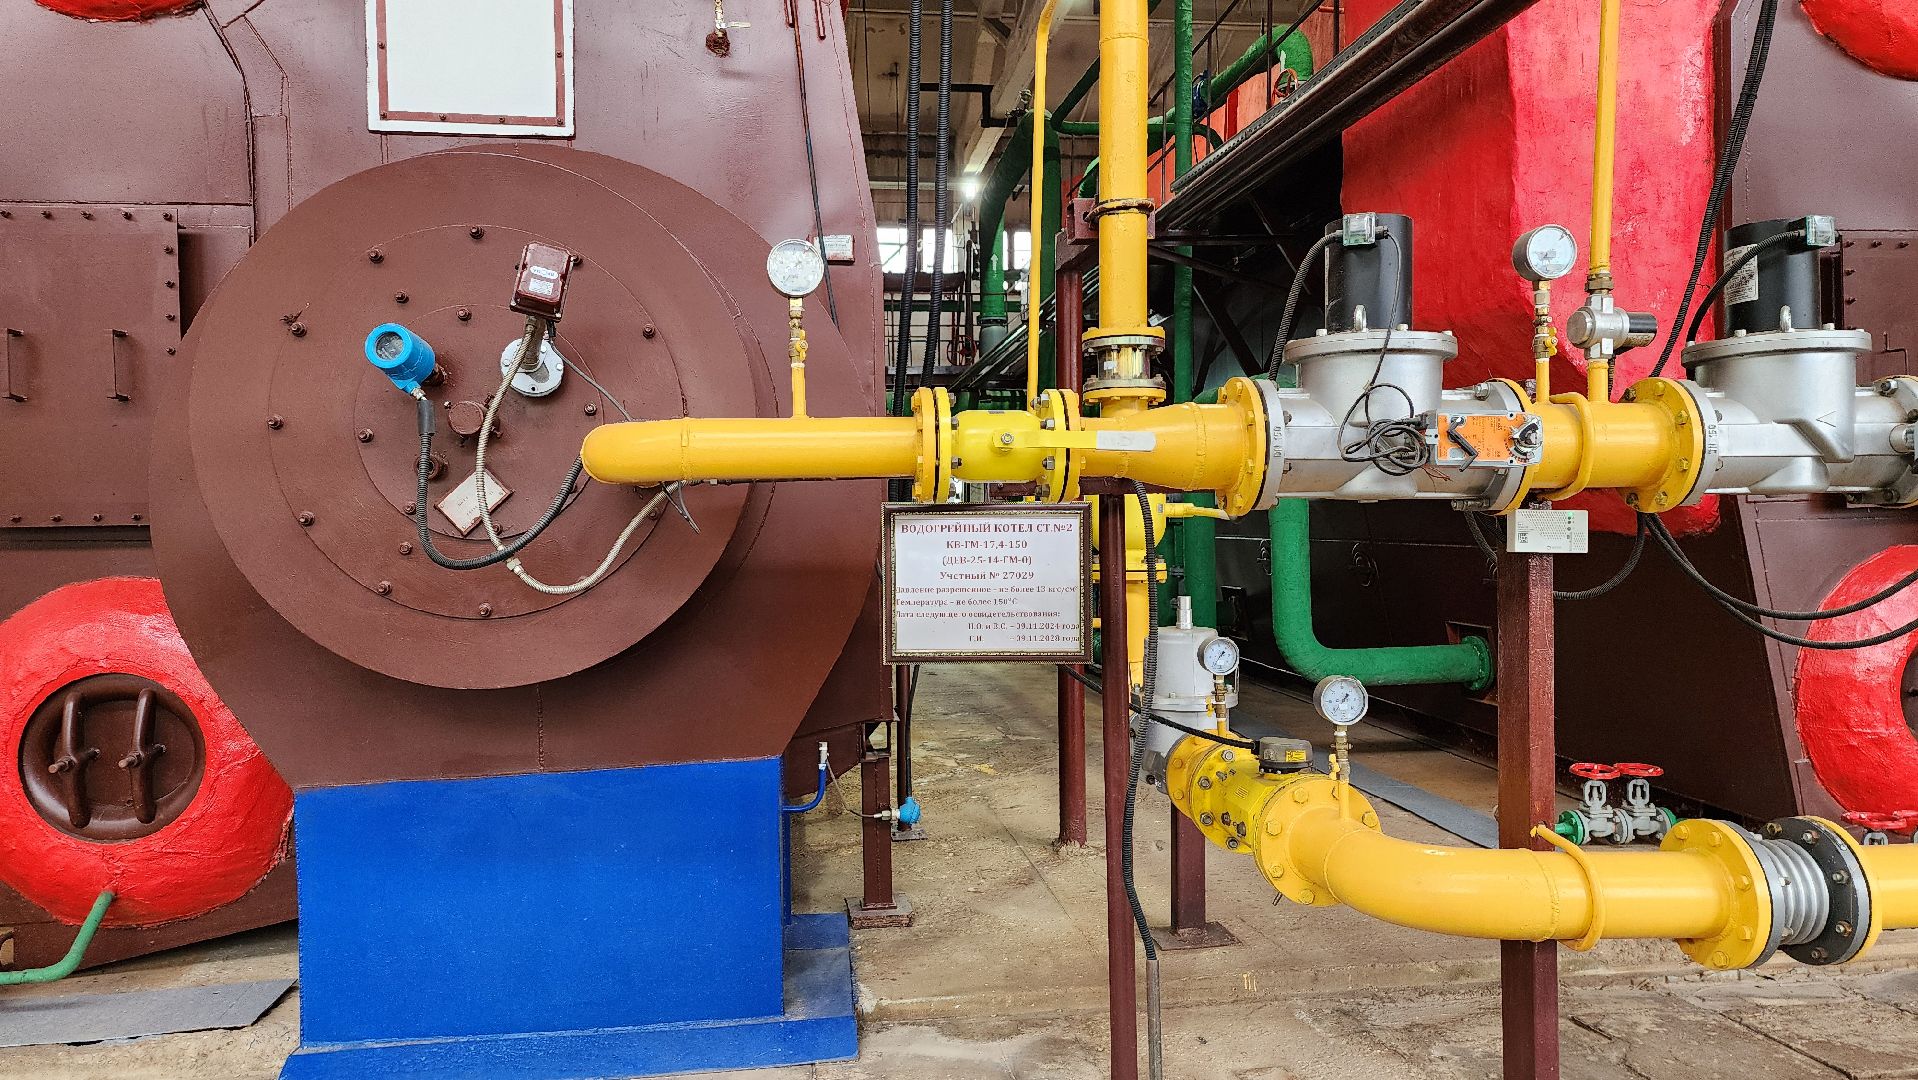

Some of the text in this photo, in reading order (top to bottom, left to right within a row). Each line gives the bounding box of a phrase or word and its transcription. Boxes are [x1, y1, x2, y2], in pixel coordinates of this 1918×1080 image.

[901, 523, 991, 534] ВОДОГРЕЙНЫЙ
[994, 524, 1033, 533] КОТЕЛ
[946, 540, 1028, 550] КВ-ГМ-17,4-150
[989, 571, 1000, 580] №
[1002, 571, 1035, 580] 27029
[1010, 585, 1035, 593] более
[1036, 585, 1046, 593] 13
[956, 598, 966, 606] не
[967, 597, 992, 606] более
[968, 610, 1061, 619] освидетельствования:
